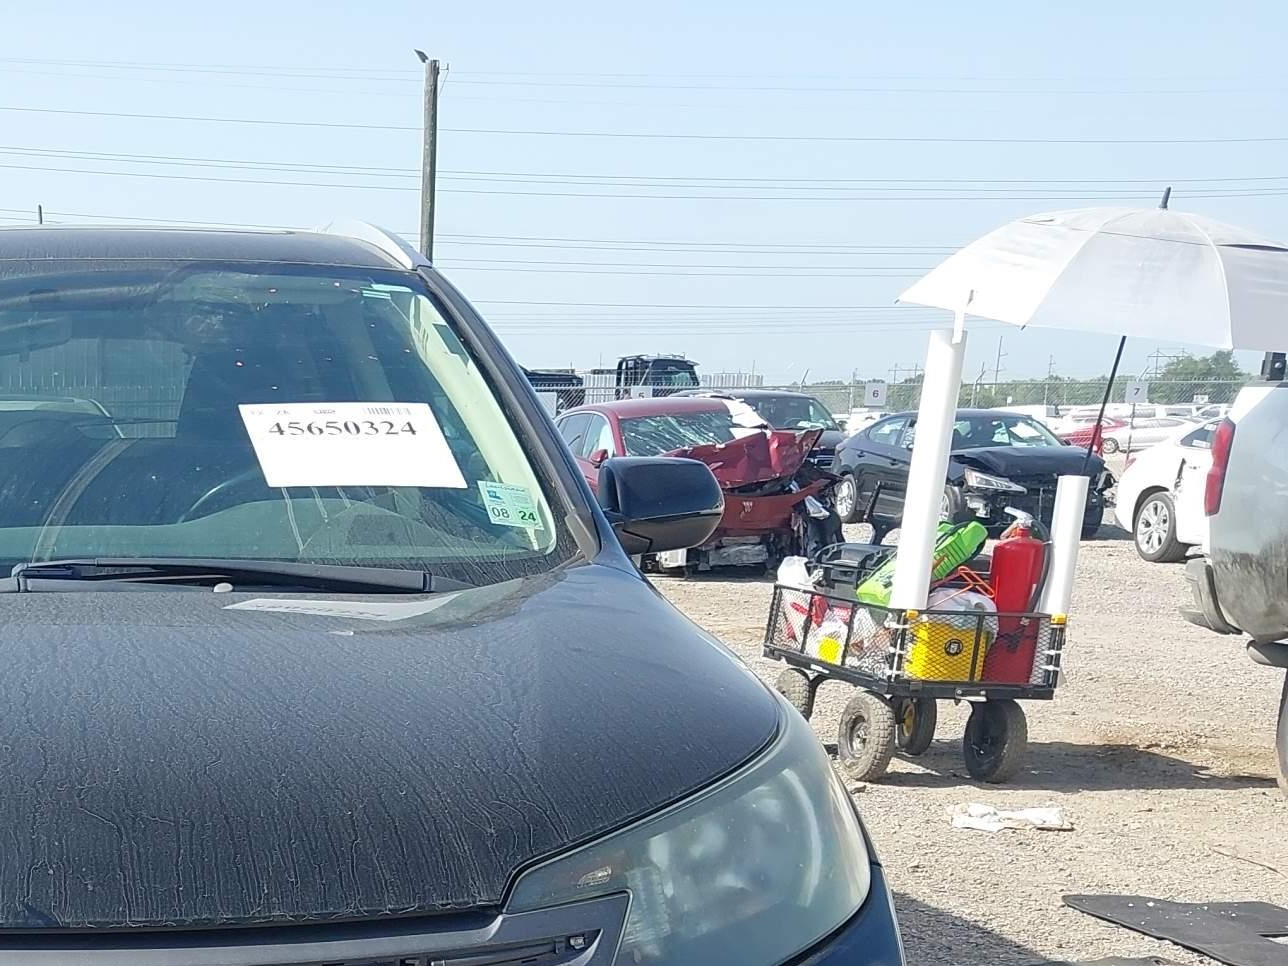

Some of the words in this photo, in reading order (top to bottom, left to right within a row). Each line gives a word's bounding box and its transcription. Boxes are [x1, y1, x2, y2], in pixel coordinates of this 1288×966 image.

[872, 390, 879, 398] 6
[268, 420, 418, 436] 45650324
[492, 506, 510, 519] 08
[518, 510, 537, 522] 24
